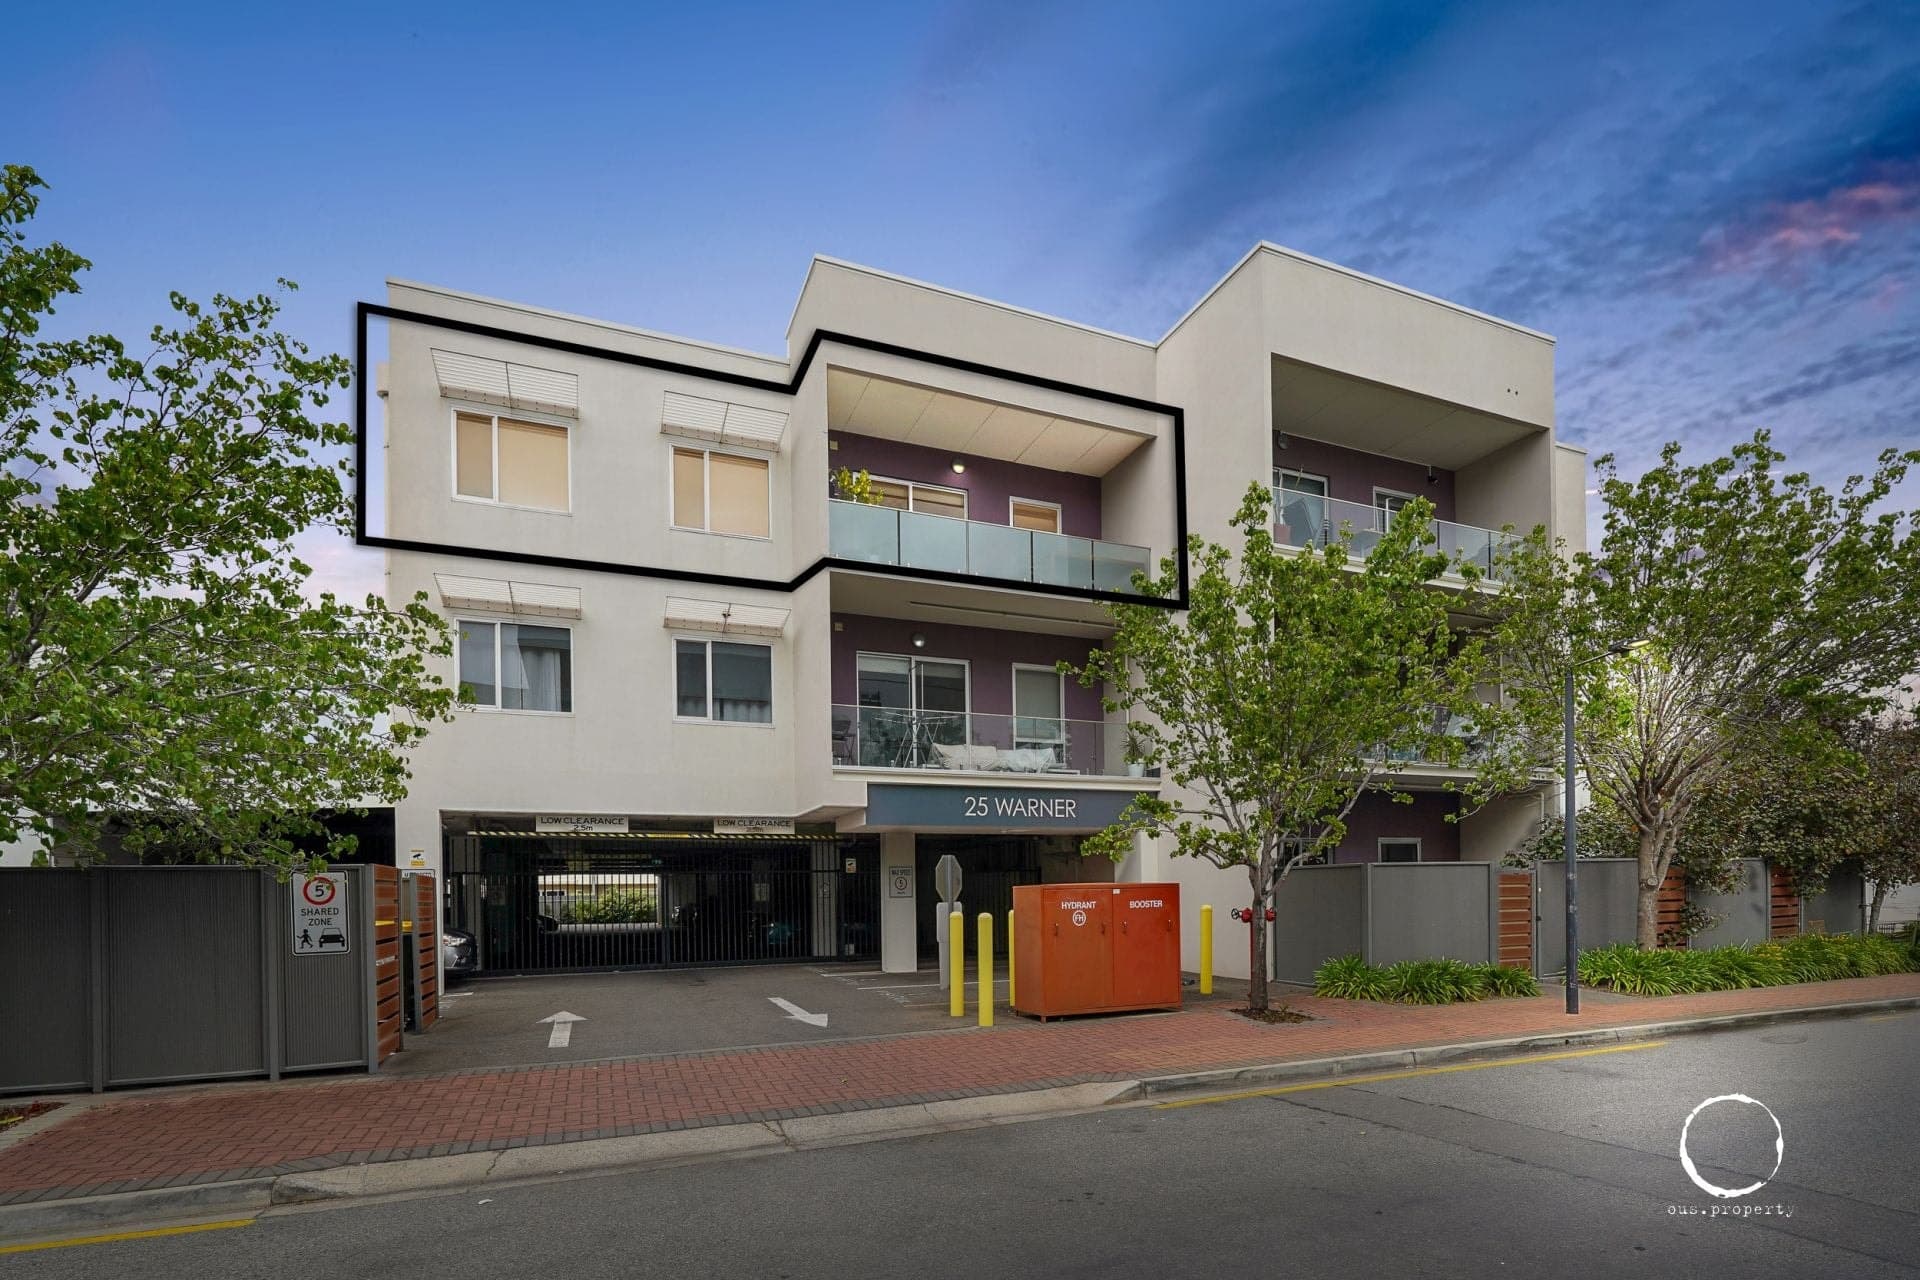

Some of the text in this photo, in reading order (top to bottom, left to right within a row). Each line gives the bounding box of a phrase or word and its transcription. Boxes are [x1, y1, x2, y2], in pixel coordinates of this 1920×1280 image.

[964, 796, 1077, 818] 25 WARNER
[540, 816, 625, 825] LOW CLEARANCE
[737, 819, 792, 827] CLEARANCE
[315, 884, 325, 898] 5
[1061, 901, 1097, 910] HYDRANT
[1129, 900, 1163, 909] BOOSTER
[300, 907, 340, 917] SHARED
[308, 918, 333, 927] ZONE
